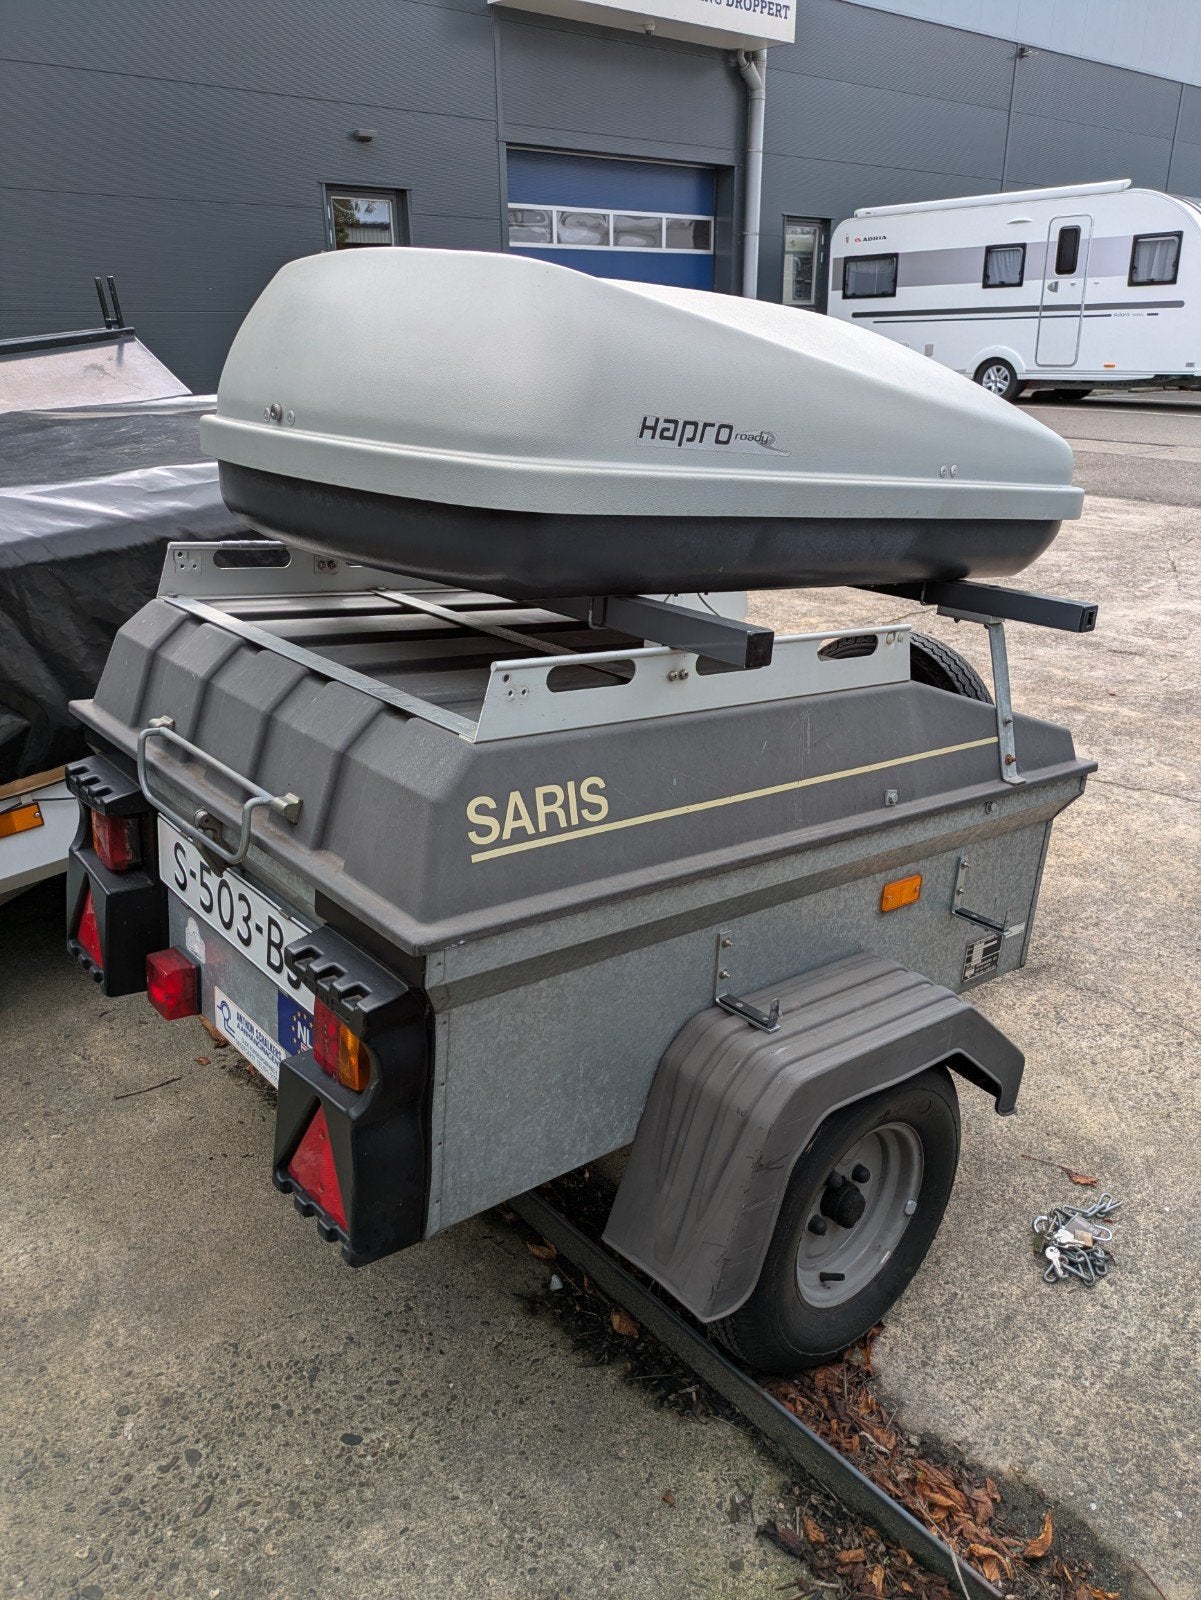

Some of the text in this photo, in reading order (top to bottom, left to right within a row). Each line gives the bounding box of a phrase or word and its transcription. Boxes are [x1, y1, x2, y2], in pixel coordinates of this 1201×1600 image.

[726, 0, 790, 20] DROPPERT
[638, 416, 769, 447] Hapro roady
[466, 775, 609, 845] SARIS
[236, 1011, 255, 1036] ANTHON
[297, 1021, 313, 1049] NL
